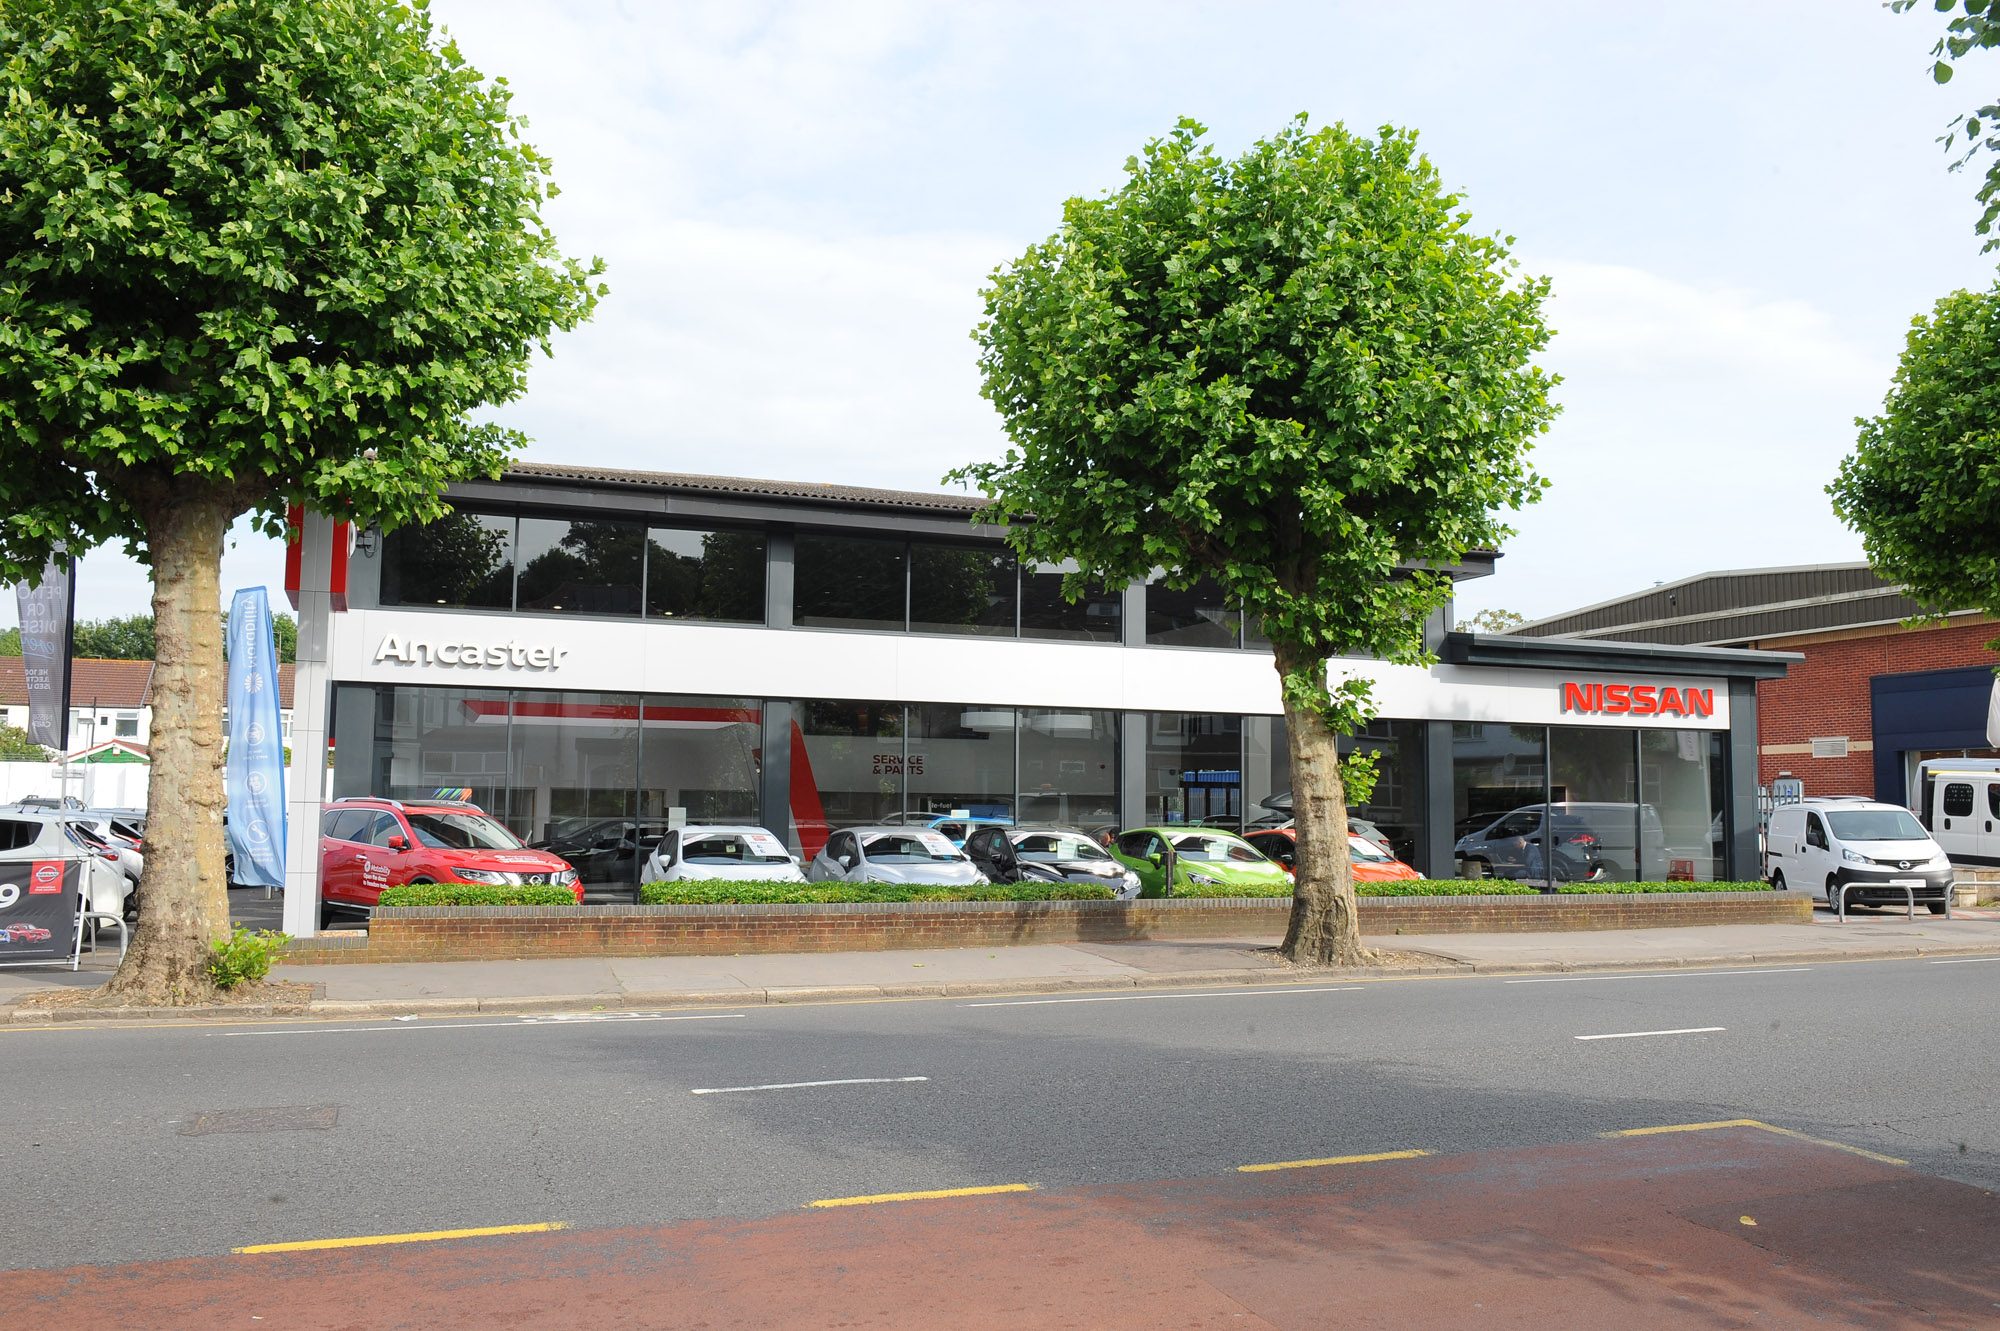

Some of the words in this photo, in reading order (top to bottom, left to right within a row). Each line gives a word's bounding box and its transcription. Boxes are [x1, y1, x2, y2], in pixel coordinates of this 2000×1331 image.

[374, 632, 568, 670] Ancaster
[1563, 682, 1714, 716] NISSAN
[872, 754, 924, 765] SERVCE
[872, 765, 882, 775] &
